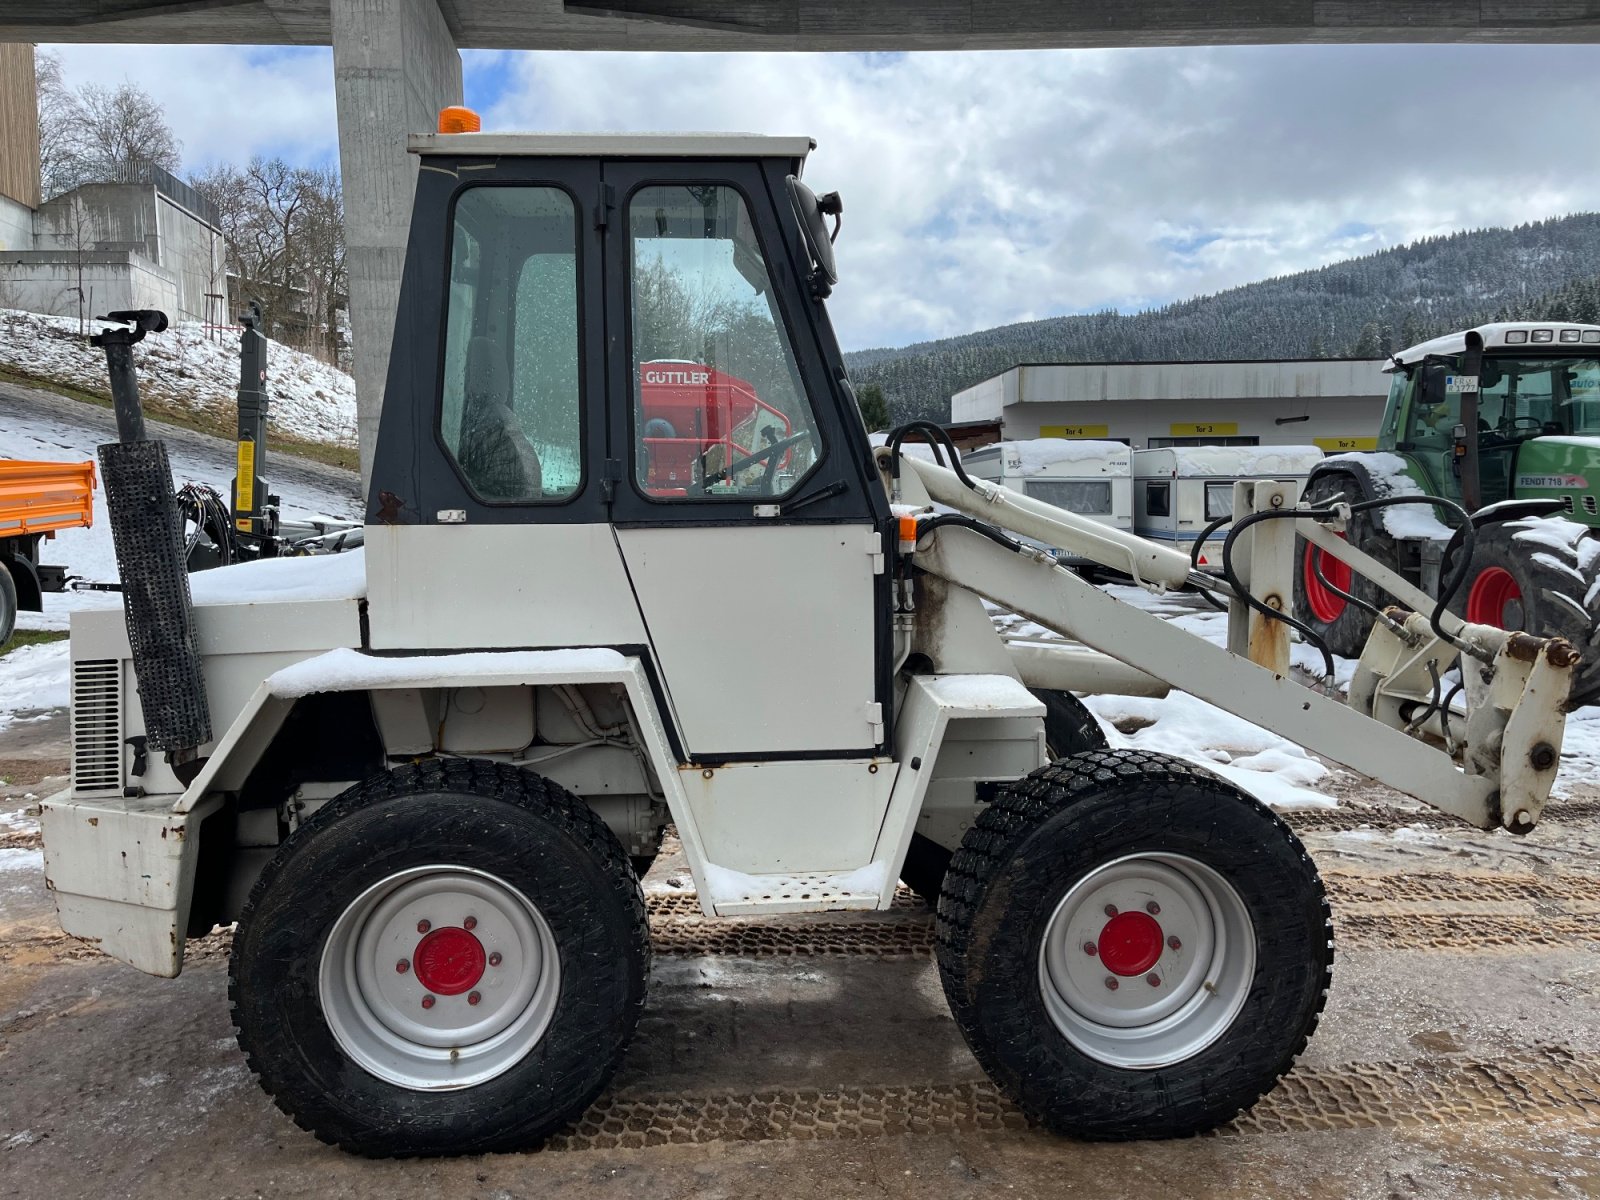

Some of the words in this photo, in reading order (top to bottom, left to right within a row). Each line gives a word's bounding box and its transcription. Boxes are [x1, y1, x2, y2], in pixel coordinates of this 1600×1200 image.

[646, 371, 709, 384] GÜTTLER
[1520, 477, 1545, 486] FENDT
[1548, 477, 1562, 486] 718
